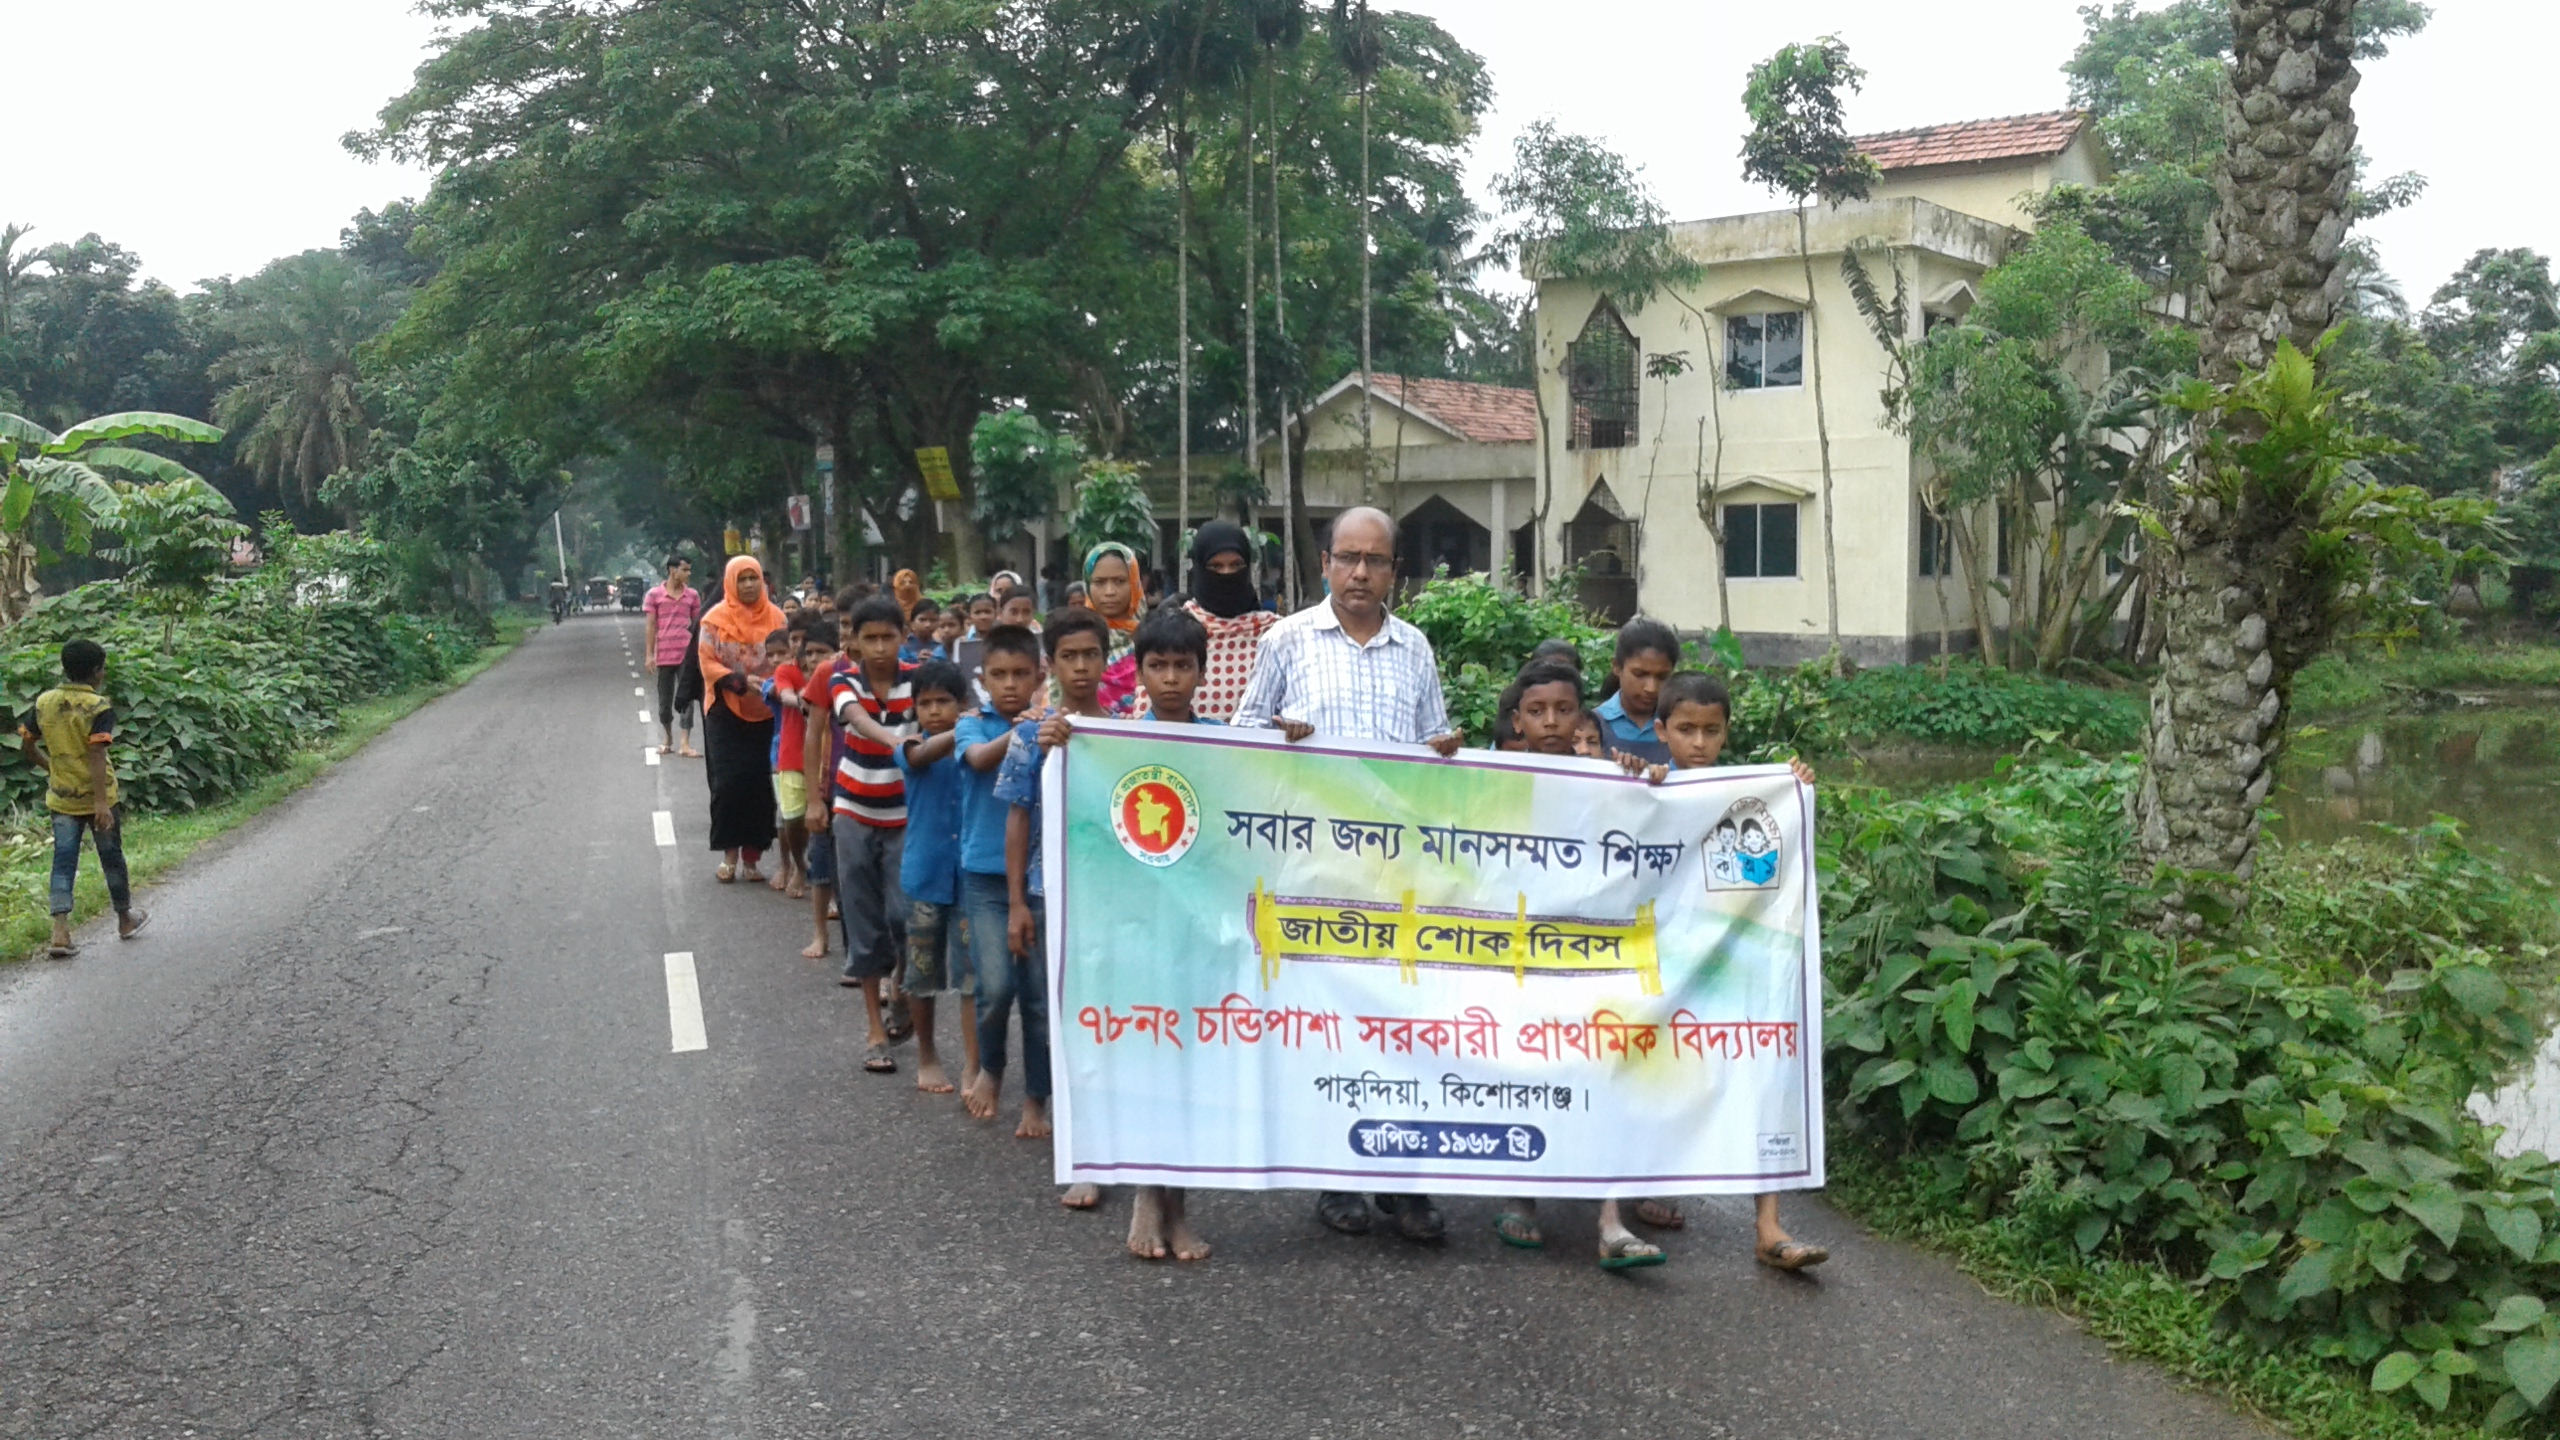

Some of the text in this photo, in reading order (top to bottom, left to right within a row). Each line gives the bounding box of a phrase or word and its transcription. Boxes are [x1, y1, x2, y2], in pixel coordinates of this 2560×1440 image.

[1224, 809, 1686, 879] সবার জন্য মানসম্মত শিক্ষা
[1277, 909, 1625, 961] জাতীয় শোক দিবস
[1078, 1004, 1183, 1050] ৭৮নং
[1354, 1005, 1502, 1060] সরকারী
[1516, 1008, 1660, 1062] প্রাথমিক
[1668, 1008, 1798, 1061] বিদ্যালয়
[1438, 1130, 1501, 1155] ১৯৬৮
